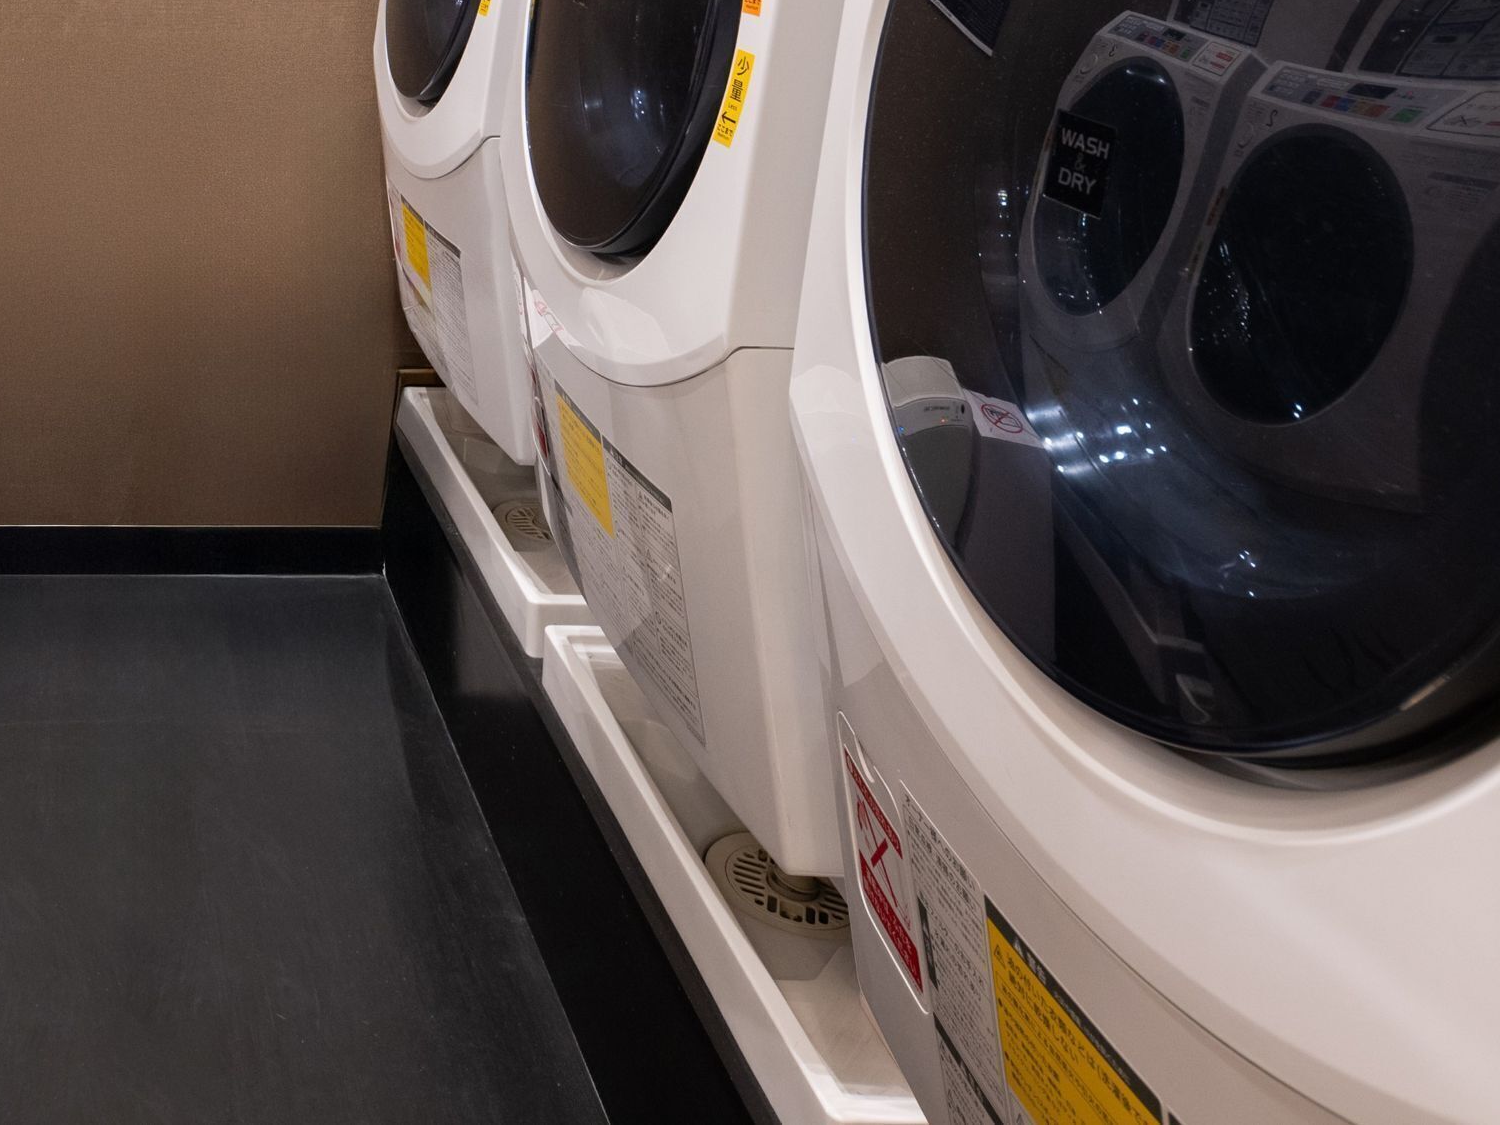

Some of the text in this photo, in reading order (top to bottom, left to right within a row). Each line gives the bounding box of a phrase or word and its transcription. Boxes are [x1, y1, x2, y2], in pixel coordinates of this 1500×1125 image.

[730, 55, 750, 103] 少量
[1061, 127, 1110, 159] WASH
[1058, 166, 1097, 194] DRY
